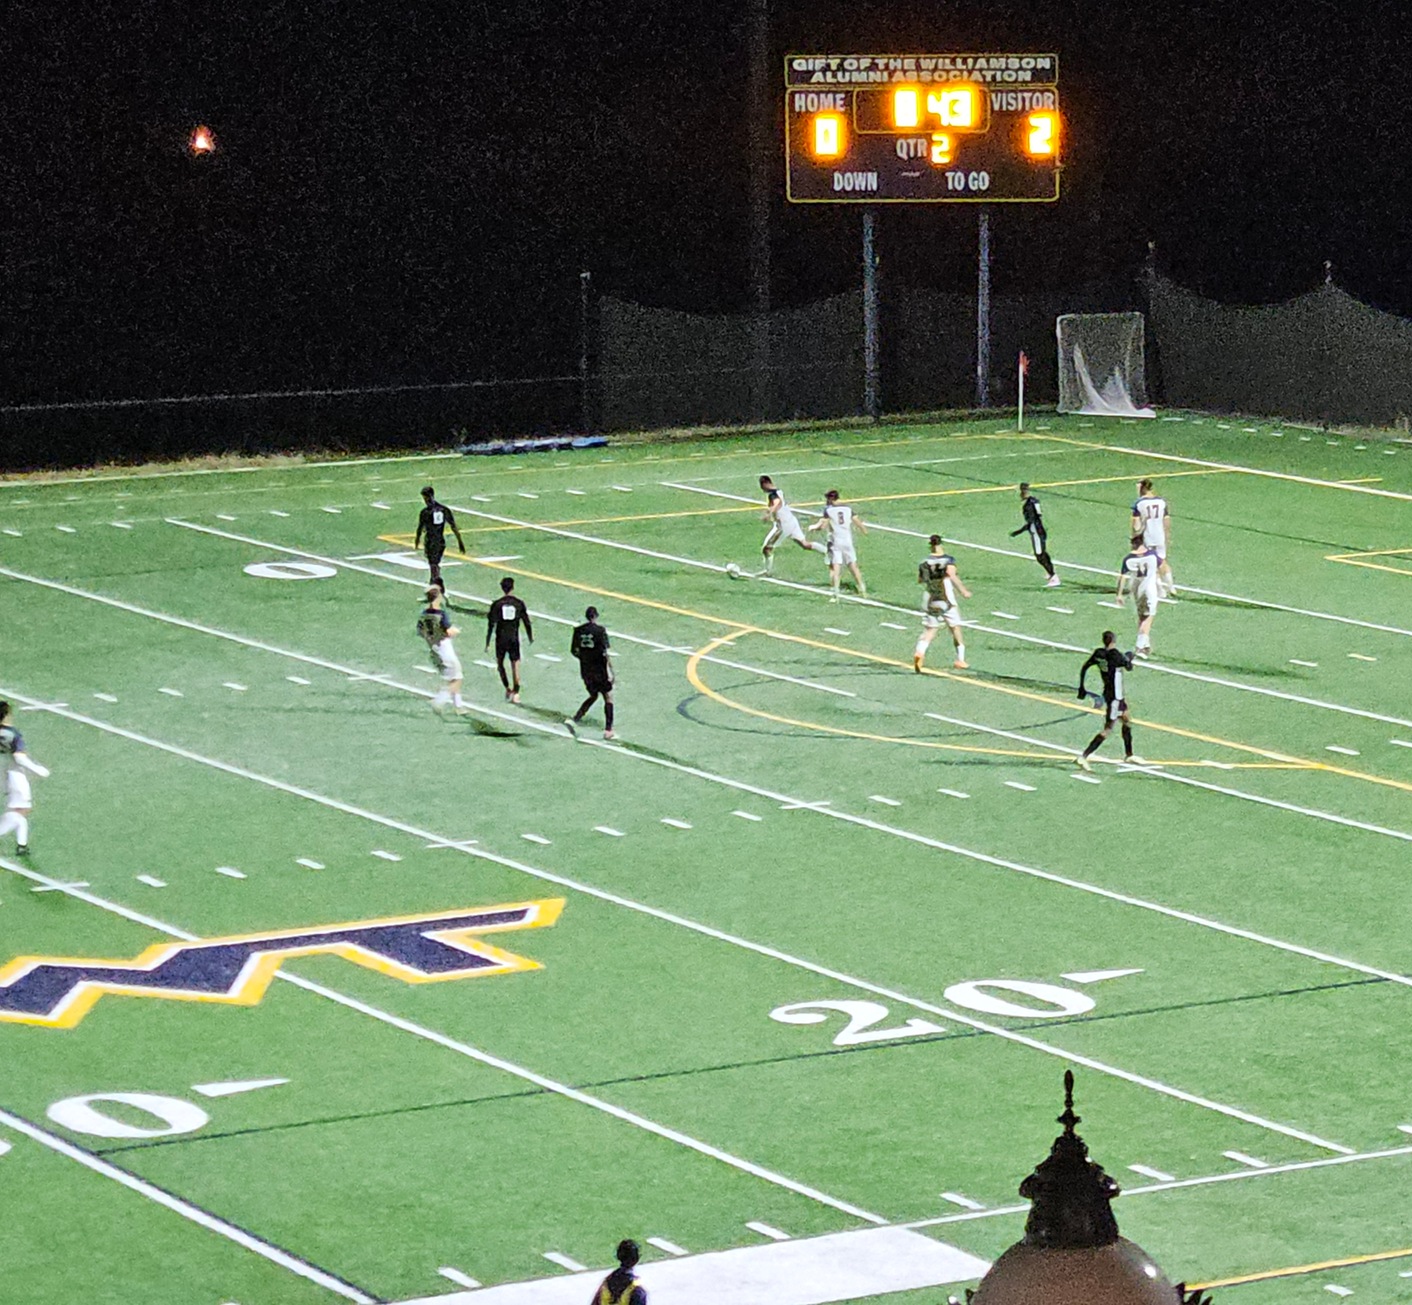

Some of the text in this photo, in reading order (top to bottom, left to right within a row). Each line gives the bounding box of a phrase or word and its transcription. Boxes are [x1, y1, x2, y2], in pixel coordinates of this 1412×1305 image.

[792, 57, 1051, 71] GIFT OF THE WILLIAMSON
[810, 70, 1032, 83] ALUMNI ASSOCIATION
[794, 93, 846, 112] HOME
[991, 92, 1055, 111] VISITOR
[815, 117, 839, 155] 0
[1027, 116, 1053, 154] 2
[896, 138, 928, 160] QTR
[931, 133, 951, 164] 2
[833, 171, 878, 191] DOWN
[945, 171, 990, 190] TO GO
[1146, 504, 1159, 519] 17
[767, 979, 1097, 1046] 20
